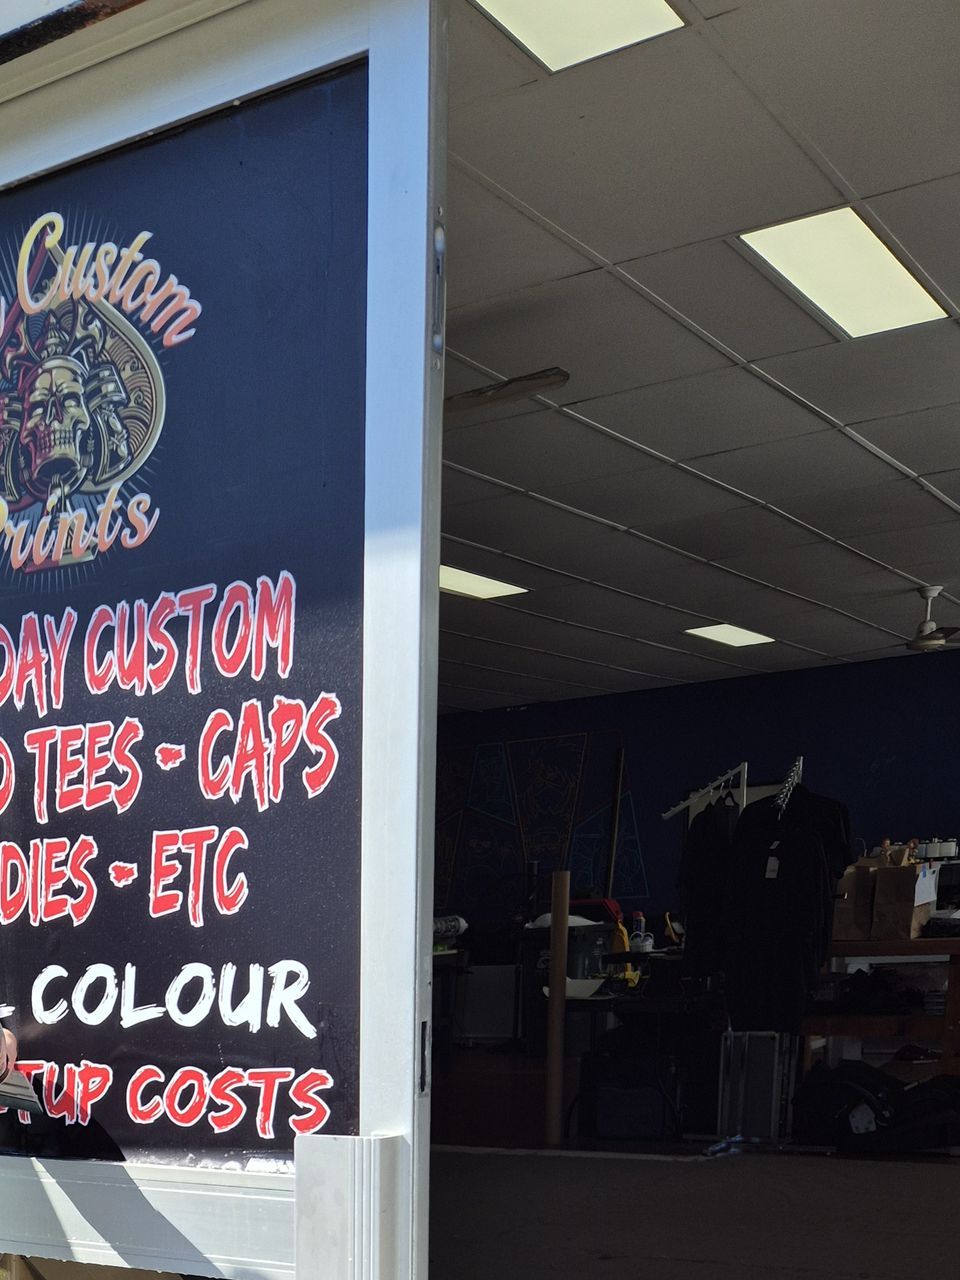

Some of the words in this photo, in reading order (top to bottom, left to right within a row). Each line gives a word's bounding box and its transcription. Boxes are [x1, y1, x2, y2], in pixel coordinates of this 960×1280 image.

[17, 211, 203, 347] Custom
[84, 570, 297, 696] CUSTOM
[25, 717, 144, 824] TEES
[197, 692, 342, 812] CAPS
[148, 825, 249, 927] ETC
[31, 959, 318, 1039] COLOUR
[126, 1065, 333, 1140] COSTS
